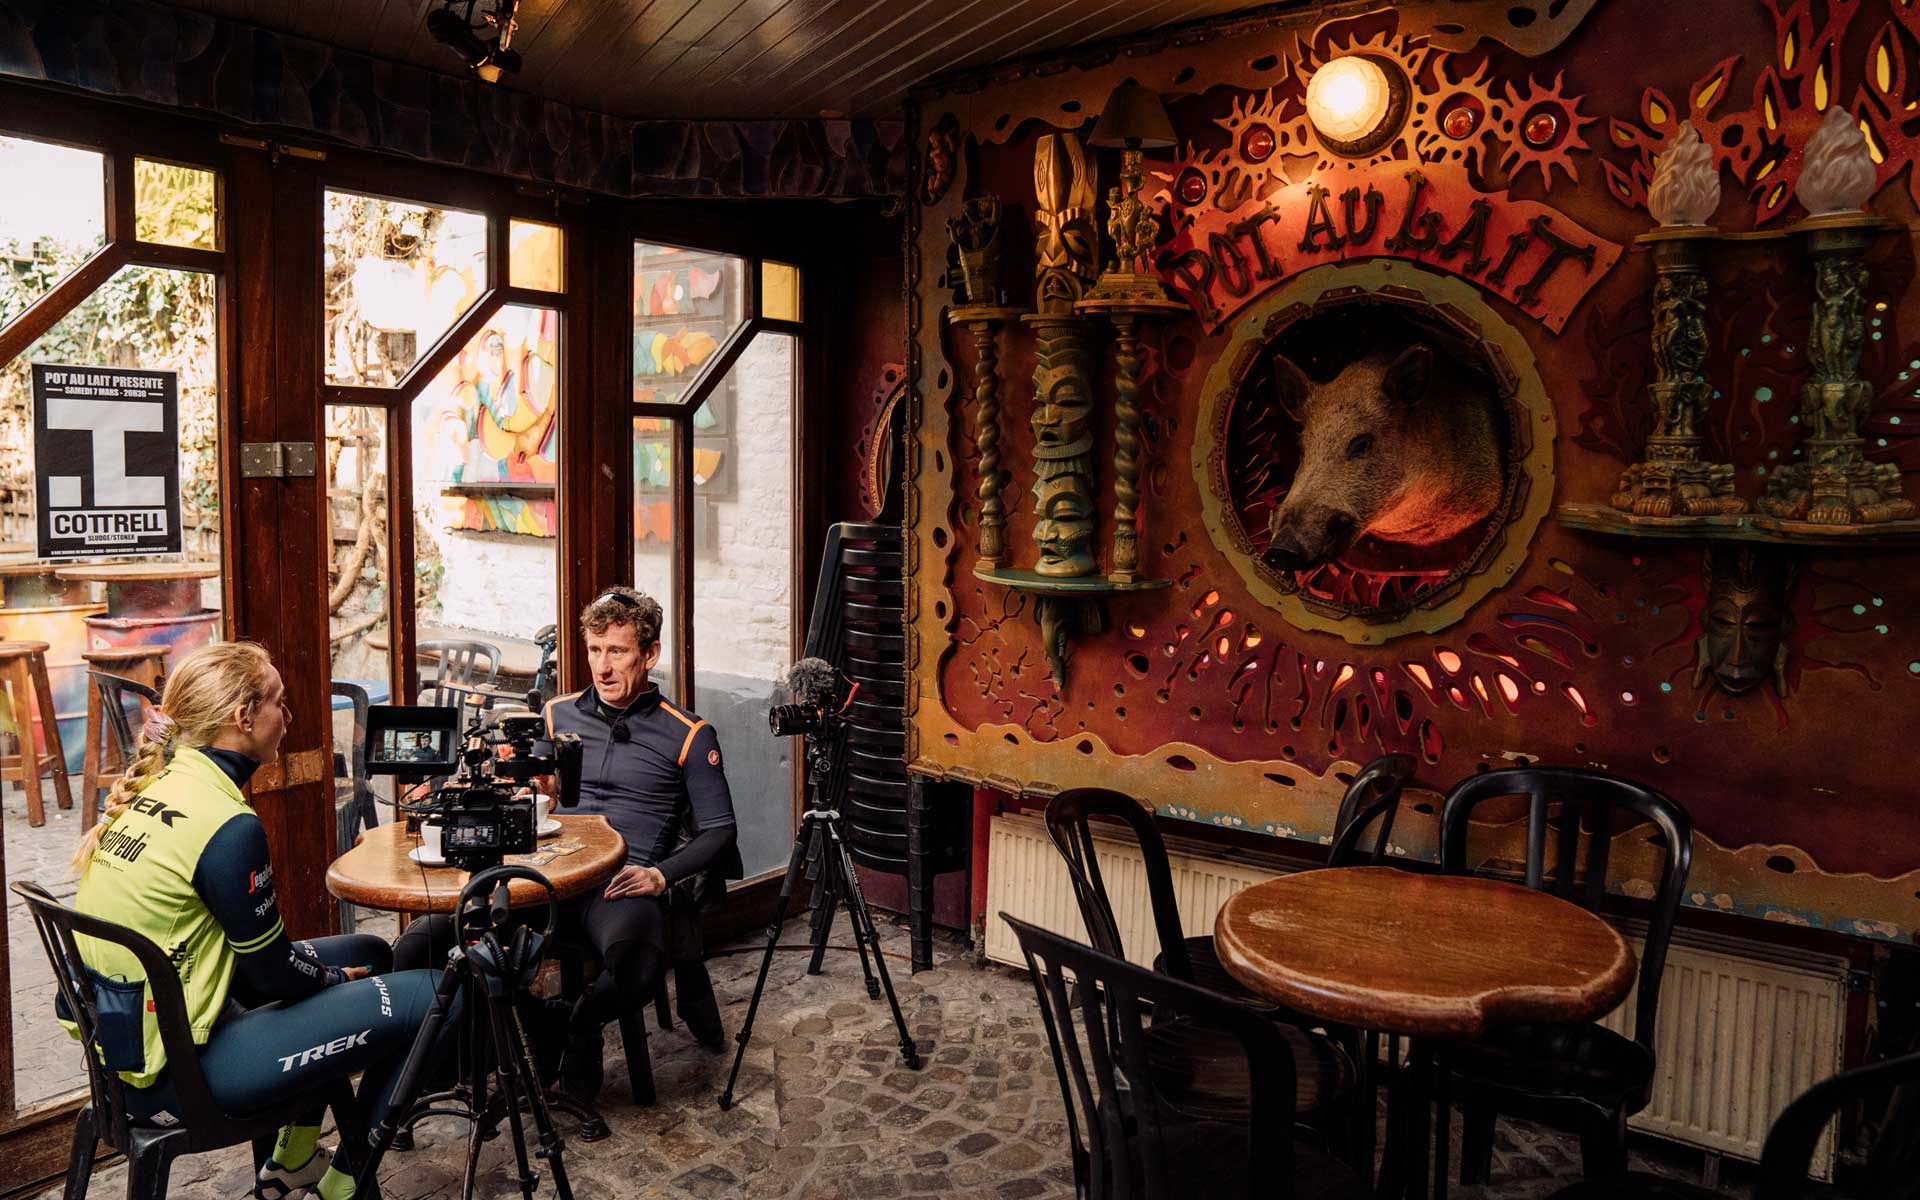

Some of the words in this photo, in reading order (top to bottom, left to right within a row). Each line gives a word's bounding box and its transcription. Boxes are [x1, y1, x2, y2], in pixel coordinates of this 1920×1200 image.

[1156, 200, 1281, 325] POT
[1298, 182, 1384, 253] AU
[1385, 169, 1597, 308] LAIT
[45, 372, 68, 385] POT
[69, 373, 86, 386] AU
[87, 374, 111, 387] LAIT
[112, 375, 164, 389] PRESENTE
[65, 386, 93, 395] SAMEDI
[93, 388, 98, 396] 7
[98, 388, 119, 396] MARS
[54, 513, 163, 534] COTTRELL
[128, 795, 189, 828] EK
[278, 1028, 372, 1073] TREK
